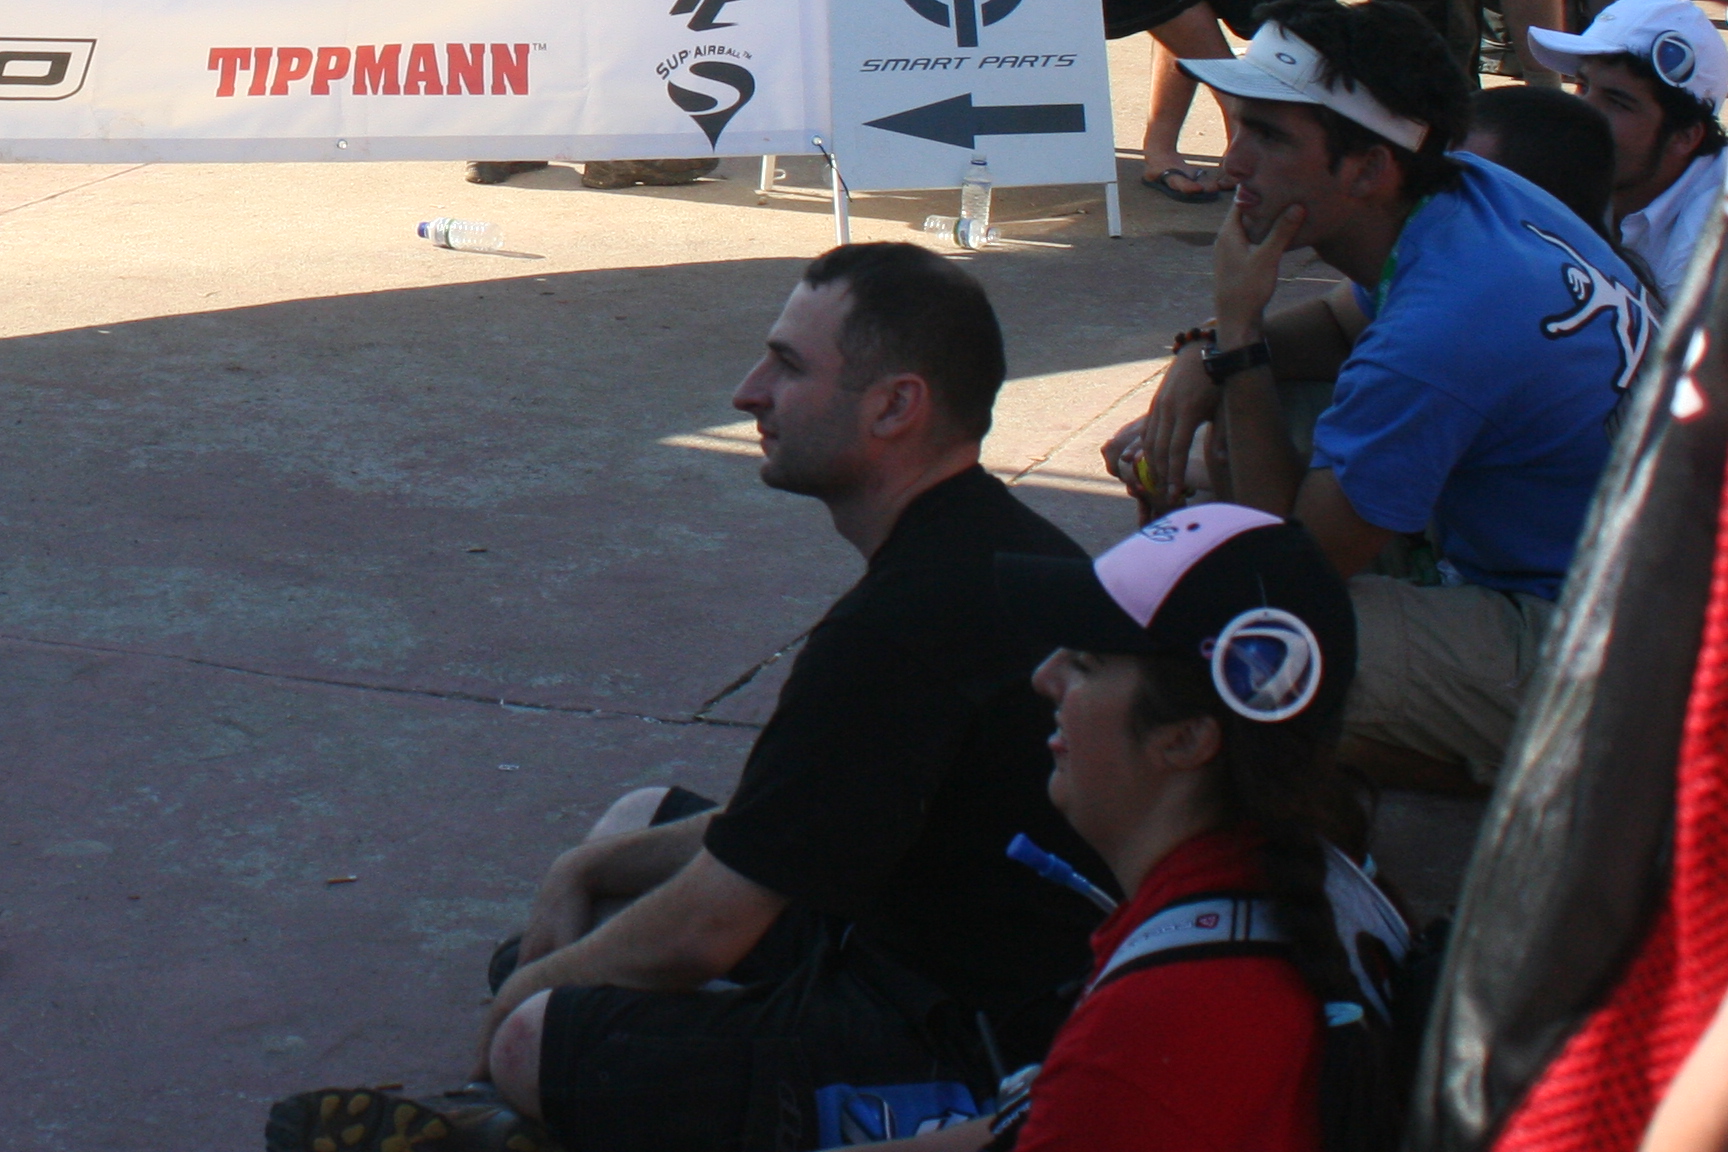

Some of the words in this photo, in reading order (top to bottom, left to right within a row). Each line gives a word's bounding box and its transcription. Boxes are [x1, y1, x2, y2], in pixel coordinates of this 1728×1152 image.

[207, 43, 530, 98] TIPPMANN
[859, 57, 971, 73] SMART
[978, 54, 1078, 69] PARTS
